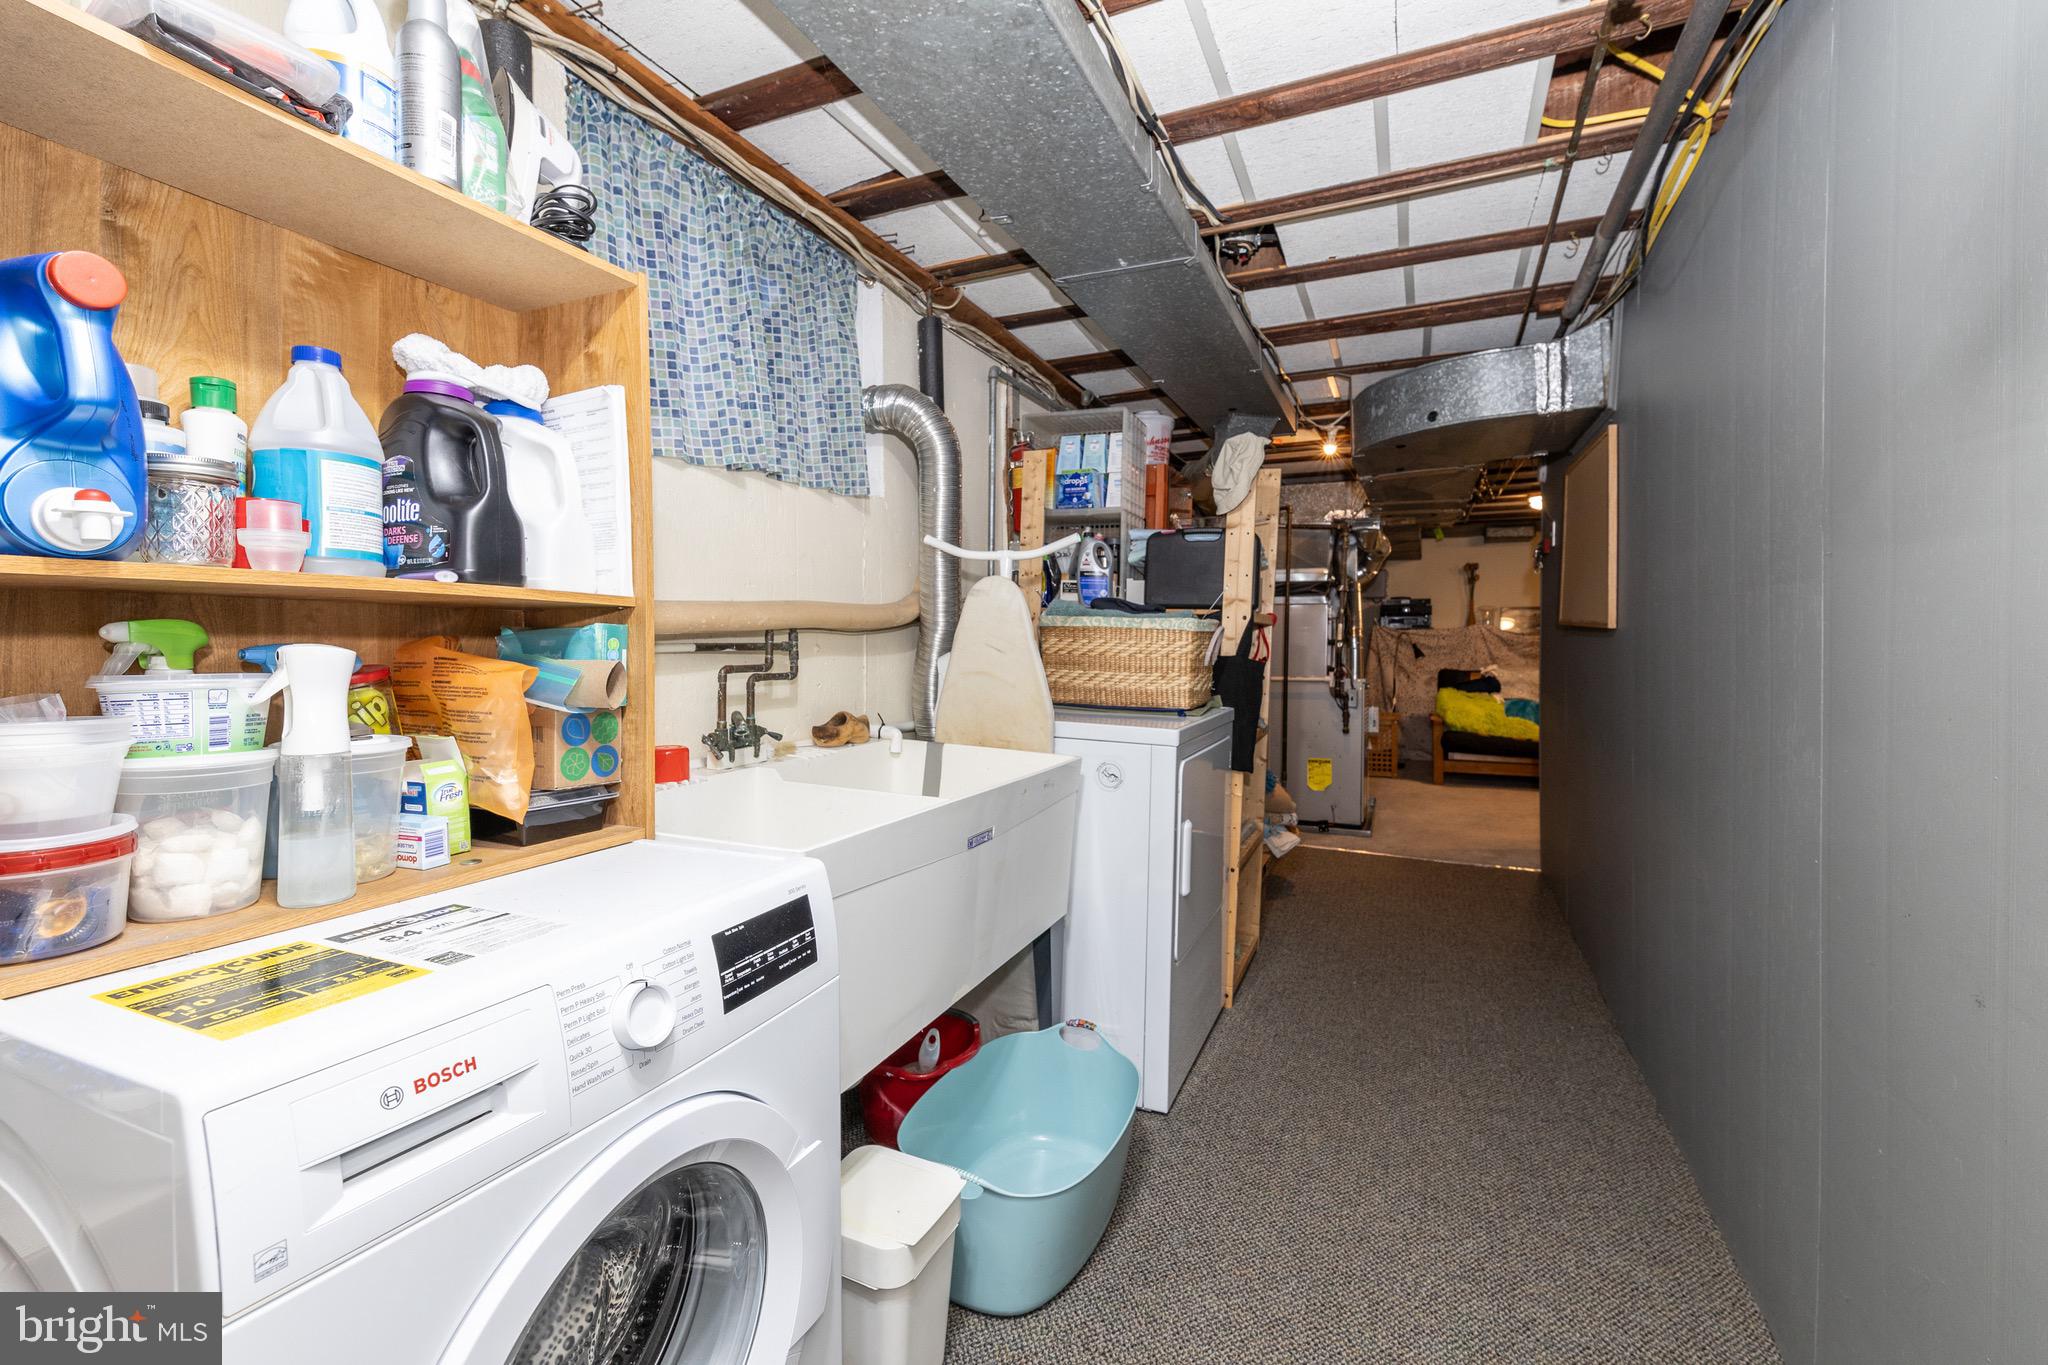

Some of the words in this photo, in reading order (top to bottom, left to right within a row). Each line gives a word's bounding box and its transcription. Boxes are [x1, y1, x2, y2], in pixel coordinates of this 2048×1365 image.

[1064, 476, 1088, 487] dropps
[383, 498, 420, 524] oolite
[384, 526, 407, 537] DARKS
[388, 533, 419, 545] DEFENSE
[556, 986, 571, 998] Perm
[571, 981, 587, 993] Press
[560, 1002, 575, 1014] Perm
[579, 995, 595, 1008] Heavy
[595, 990, 606, 1001] Soil
[563, 1019, 578, 1031] Perm
[583, 1010, 596, 1024] Light
[596, 1006, 607, 1016] Soil
[566, 1031, 591, 1047] Delicates
[682, 1025, 695, 1036] Drum
[568, 1050, 585, 1063] Quick
[584, 1046, 593, 1056] 30
[570, 1060, 599, 1078] Rinse/Spin
[638, 1057, 652, 1070] Drain
[413, 1056, 478, 1095] BOSCH
[571, 1080, 587, 1095] Hand
[586, 1066, 615, 1086] Wash/Wool
